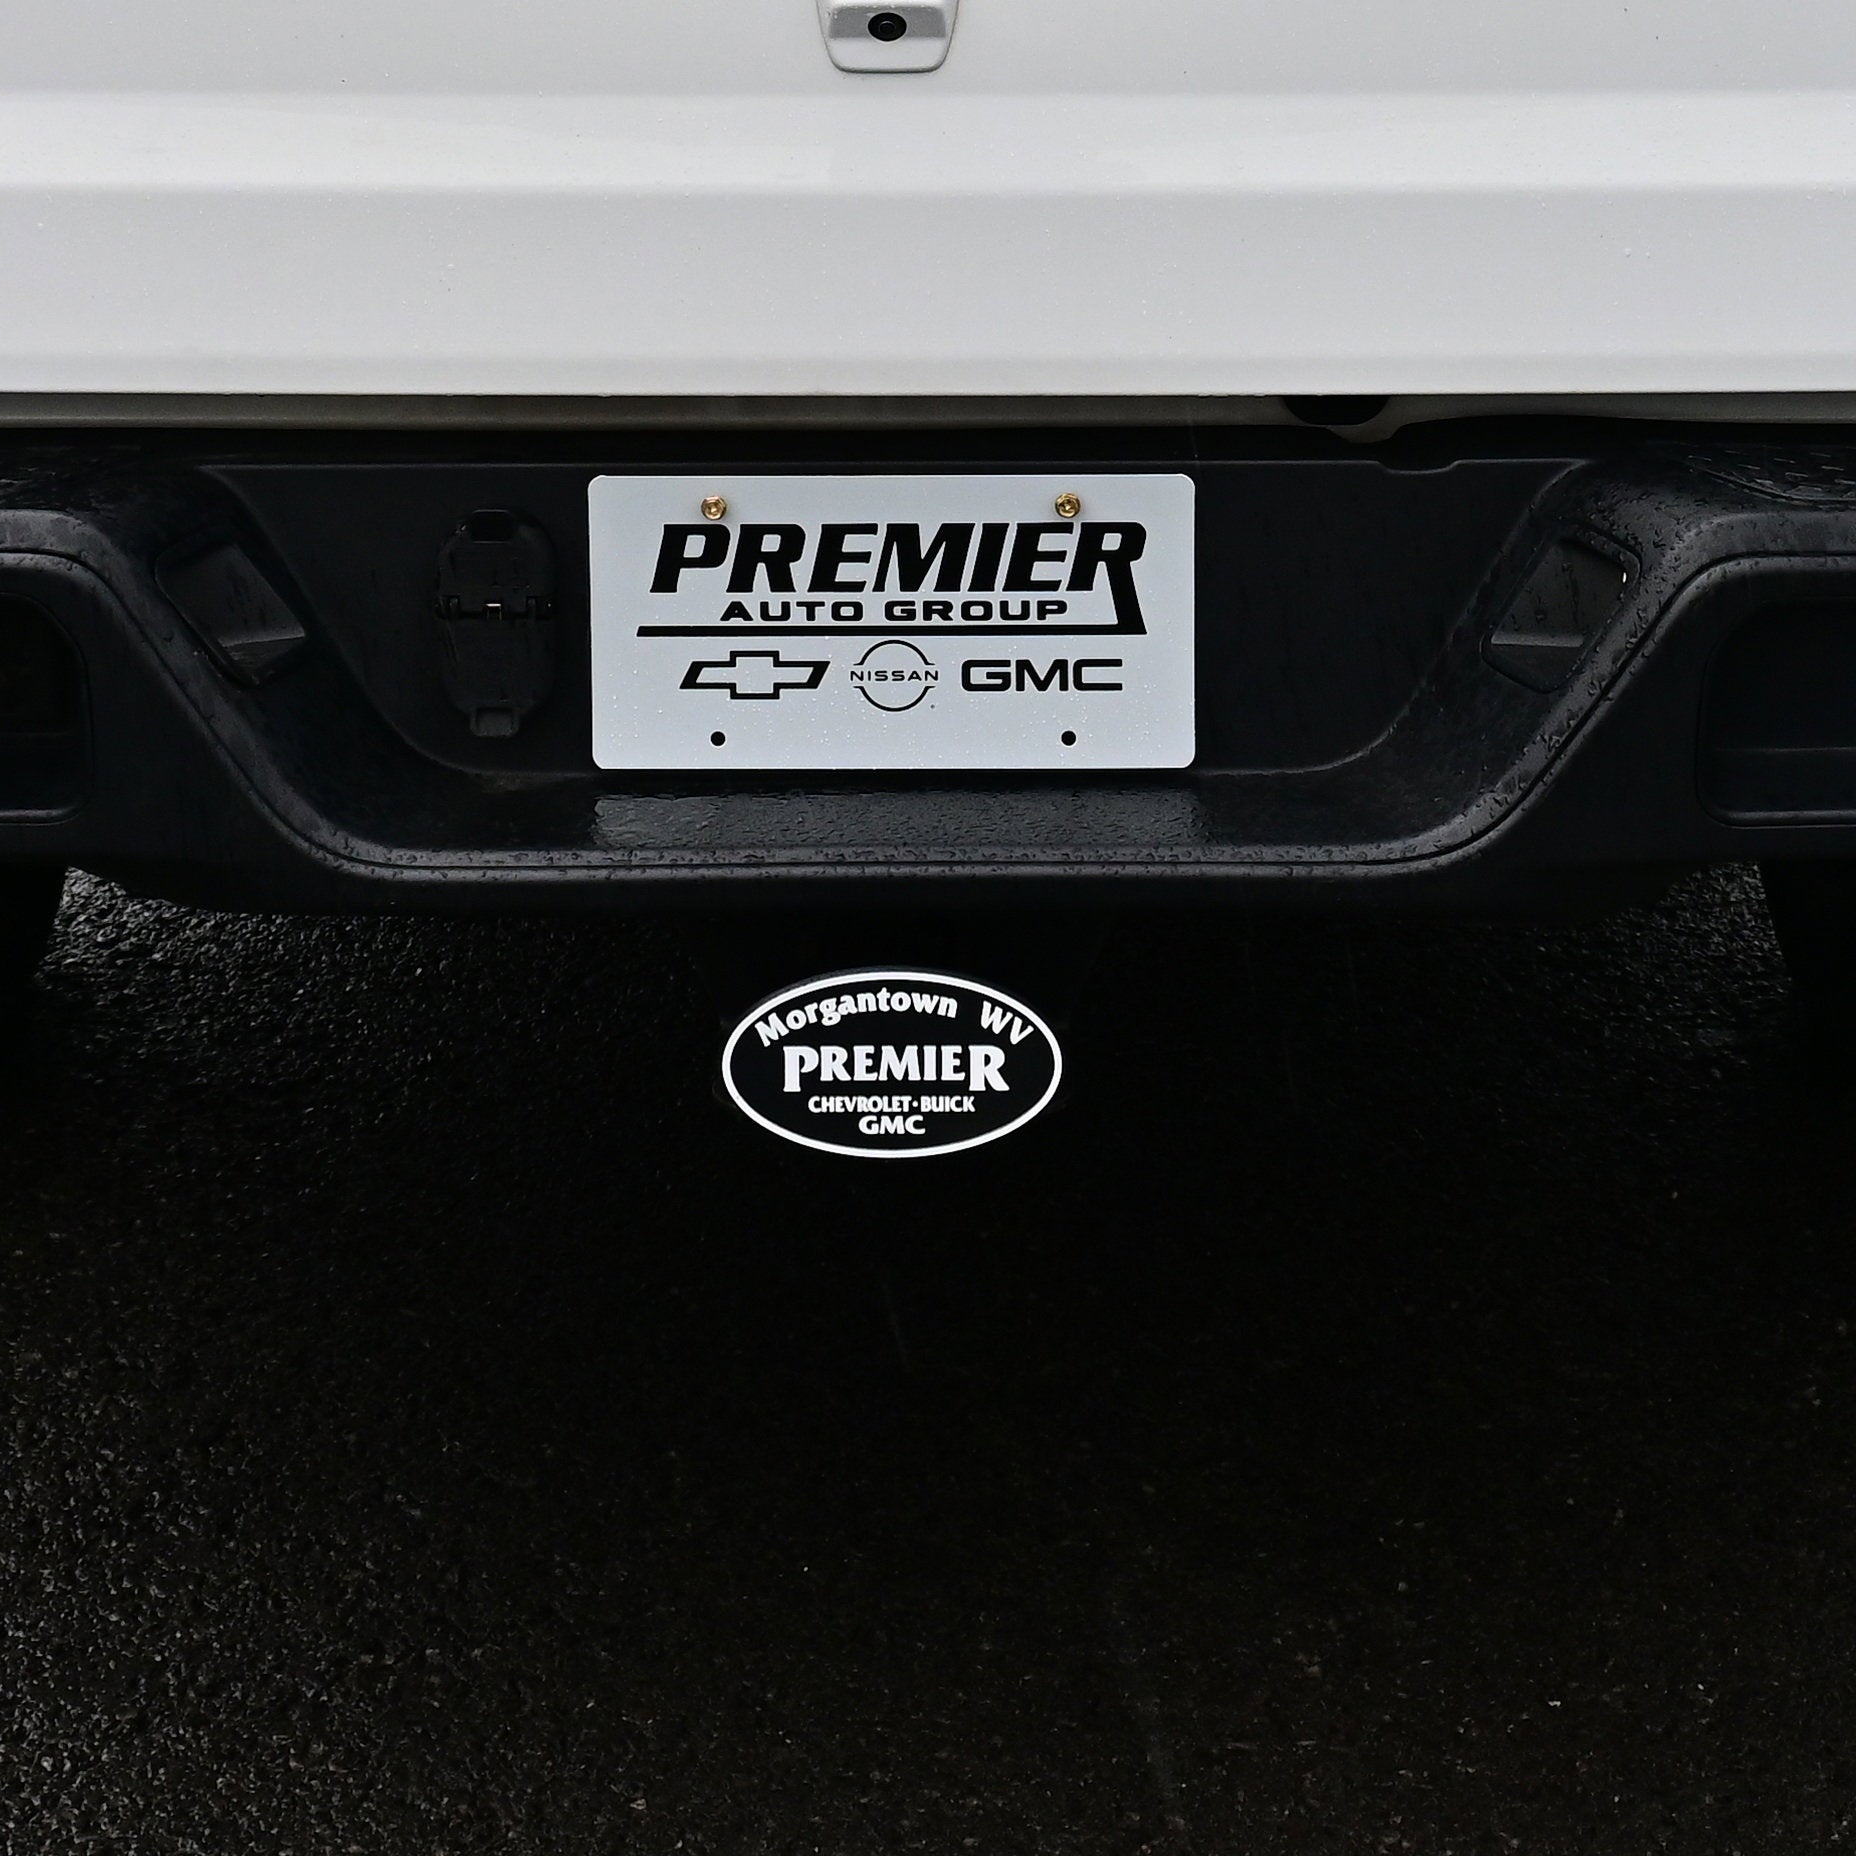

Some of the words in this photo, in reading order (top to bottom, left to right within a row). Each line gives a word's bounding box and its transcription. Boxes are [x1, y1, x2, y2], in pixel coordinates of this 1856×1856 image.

[649, 521, 1147, 635] PREMIER
[719, 600, 864, 622] AUTO
[884, 600, 1068, 622] GROUP
[850, 670, 939, 682] NISSAN
[961, 658, 1123, 691] GMC
[754, 987, 958, 1047] Morgantown
[979, 1001, 1035, 1045] WV
[782, 1044, 1010, 1093] PREMIER
[858, 1114, 926, 1135] GMC
